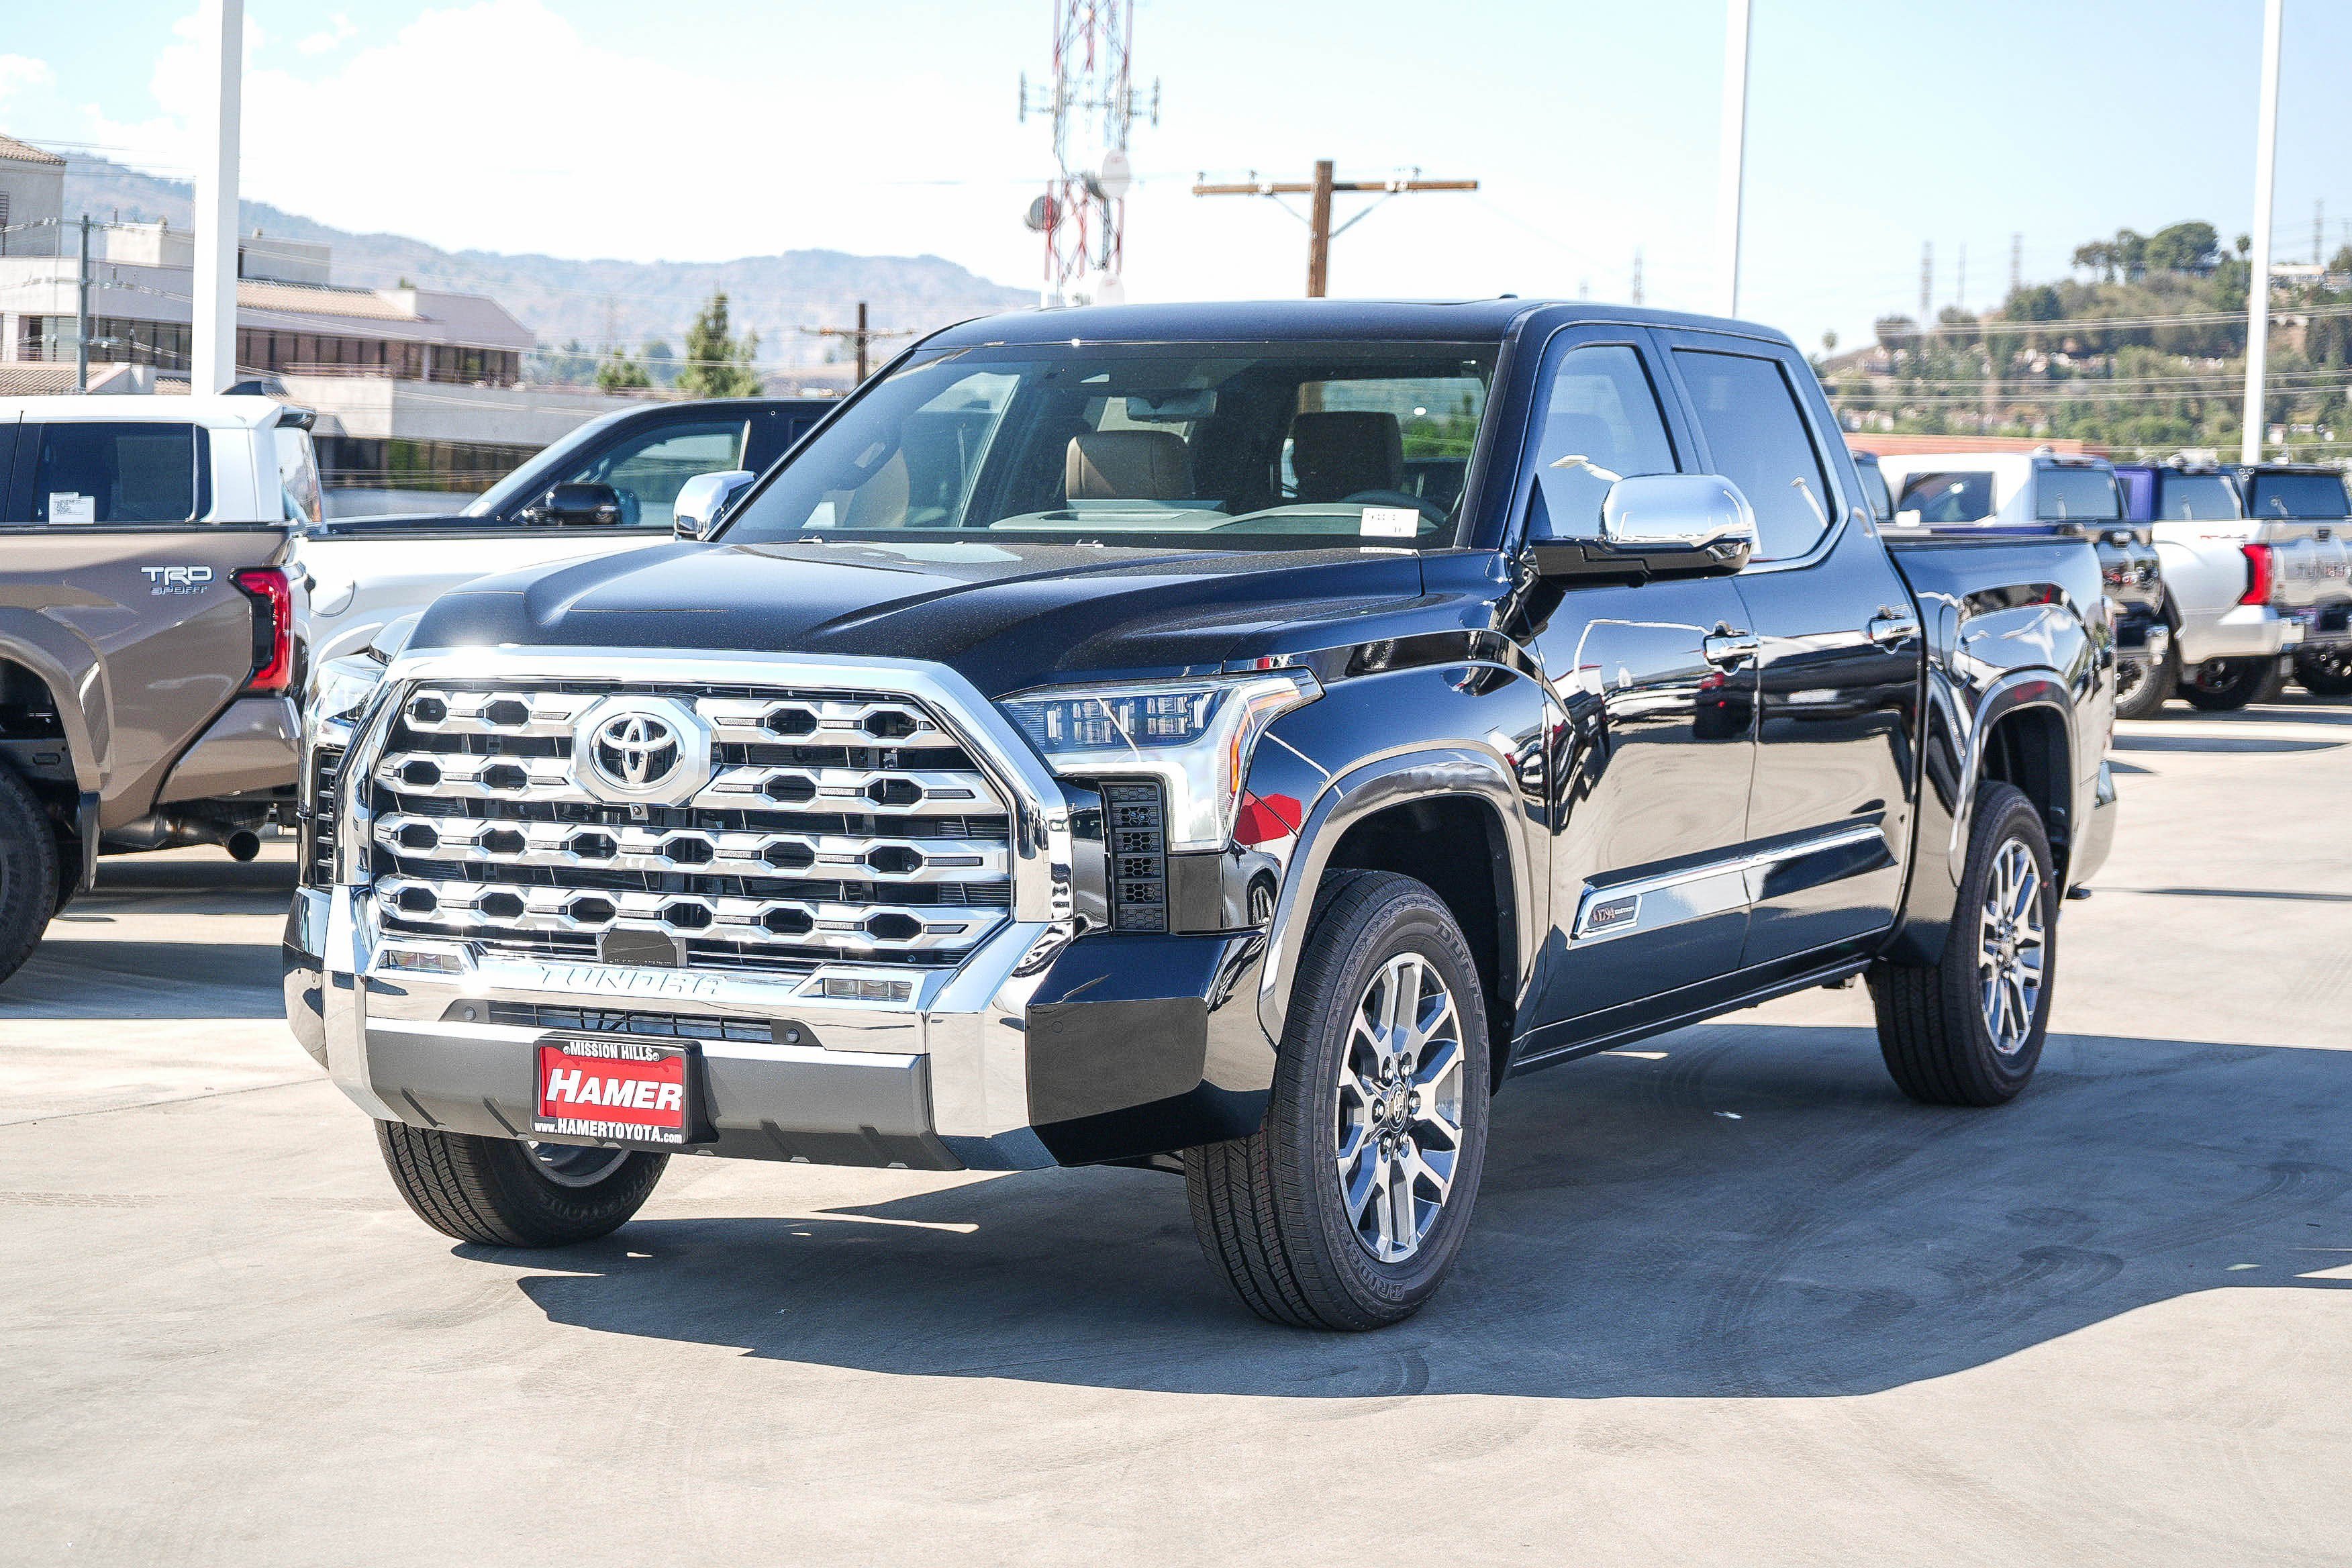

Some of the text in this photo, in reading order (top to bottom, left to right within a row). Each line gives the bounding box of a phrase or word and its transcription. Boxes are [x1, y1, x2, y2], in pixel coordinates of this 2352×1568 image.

[140, 566, 213, 585] TRD
[570, 1042, 652, 1061] MISSION HILLS
[546, 1068, 683, 1112] HAMER
[534, 1118, 683, 1144] www.HAMERTOYOTA.com
